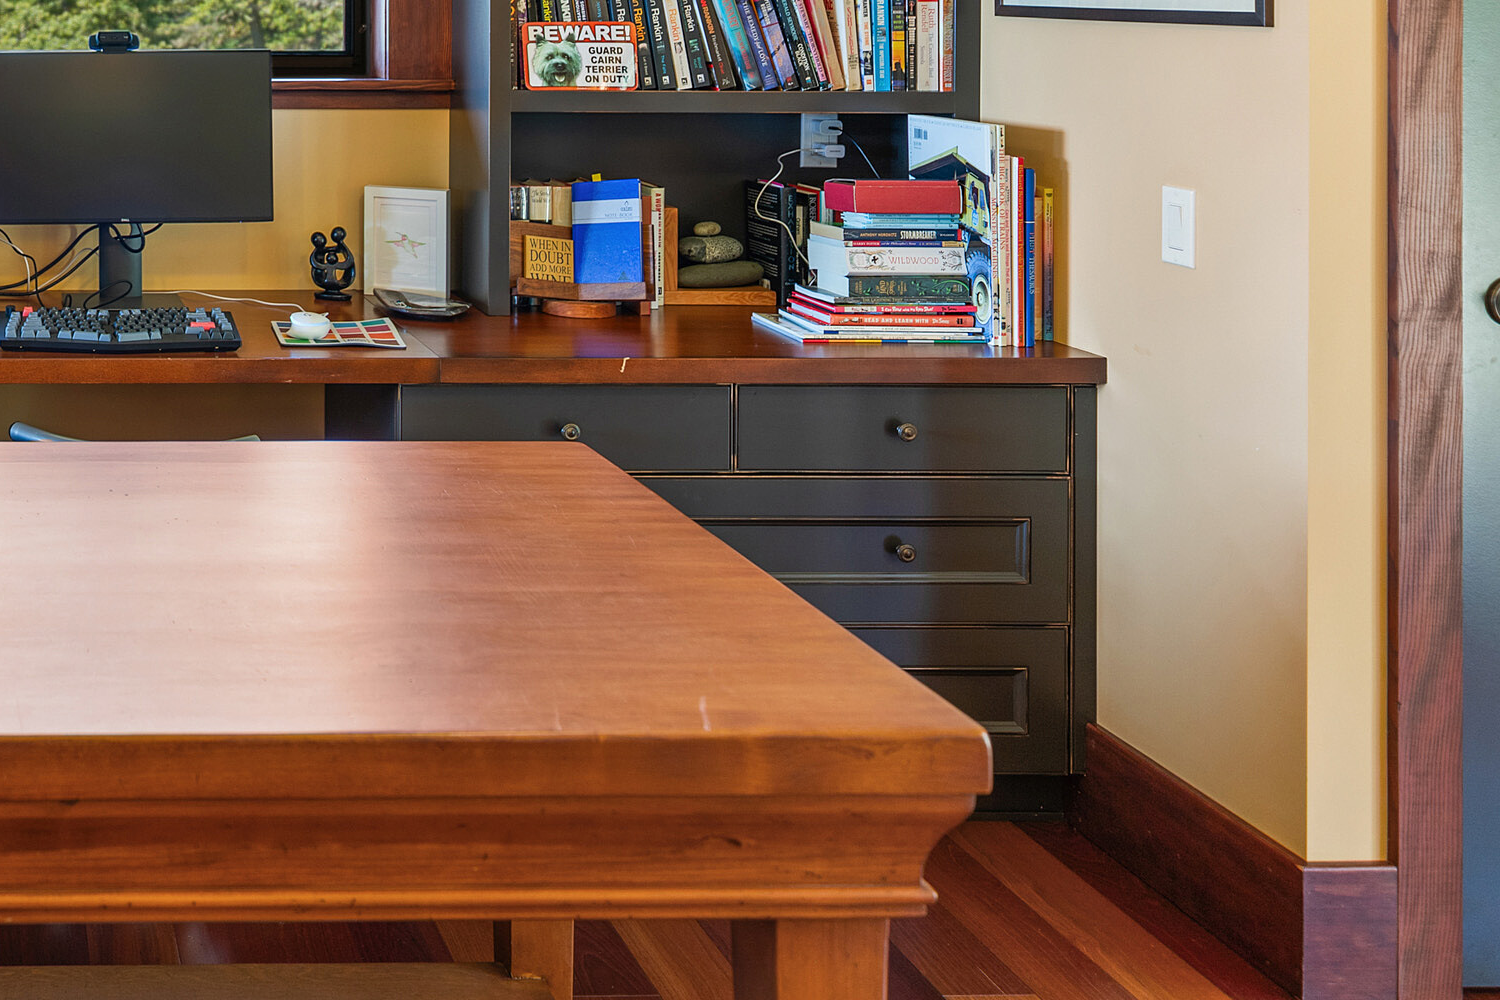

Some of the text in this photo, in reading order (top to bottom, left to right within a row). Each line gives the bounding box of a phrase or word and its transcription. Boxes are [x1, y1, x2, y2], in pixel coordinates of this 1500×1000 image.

[634, 8, 644, 41] Rankin
[652, 8, 662, 41] Rankin
[684, 5, 695, 32] Rankin
[528, 25, 631, 41] BEWARE!
[999, 209, 1005, 218] OF
[900, 231, 936, 239] STORMBREAKER
[530, 238, 571, 251] WHEN IN
[530, 250, 571, 265] DOUBT
[530, 264, 571, 275] ADD MORE
